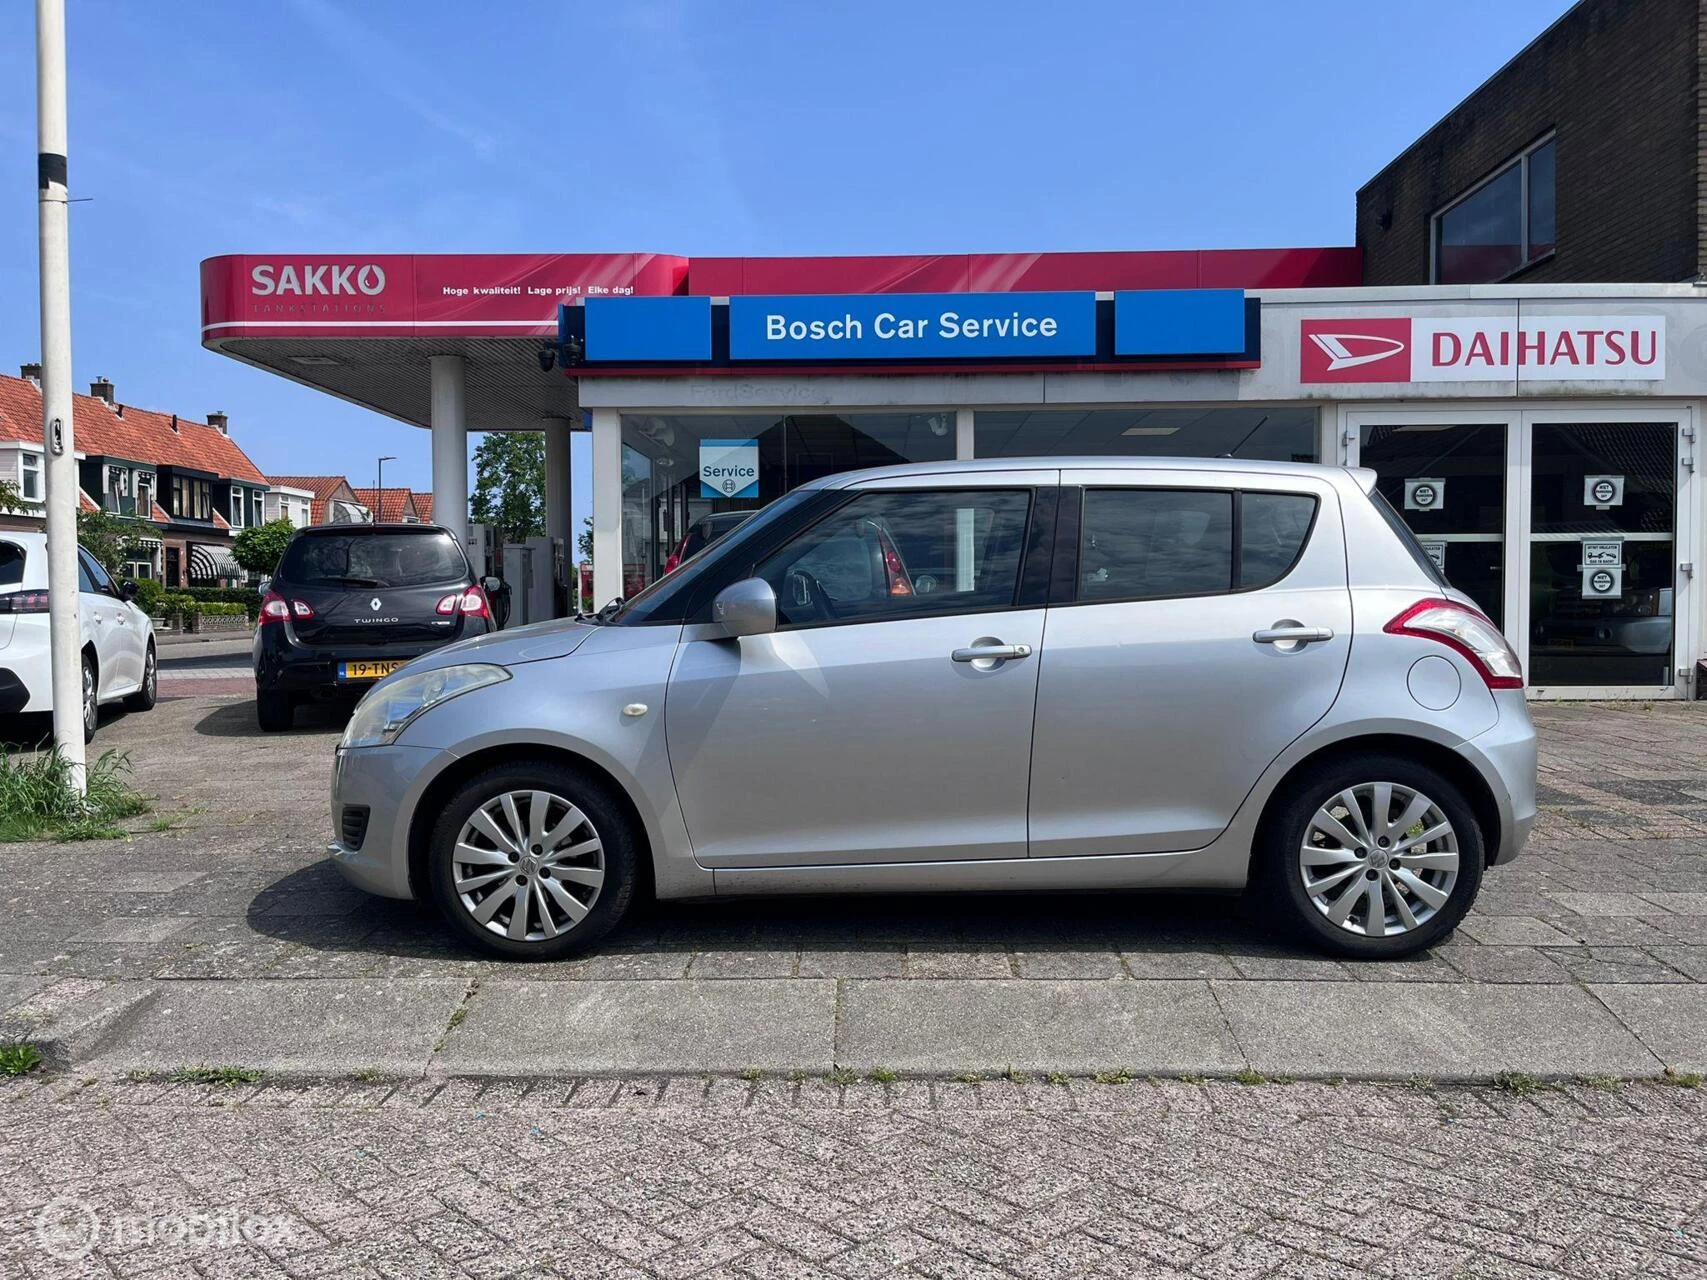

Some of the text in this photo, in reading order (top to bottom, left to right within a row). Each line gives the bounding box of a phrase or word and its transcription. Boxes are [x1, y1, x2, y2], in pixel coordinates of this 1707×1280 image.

[251, 264, 386, 296] SAKKO
[443, 286, 634, 296] Hoge kwaliteit! Lage prijs! Elke dag!
[253, 303, 386, 313] TANKSTATIONS
[766, 311, 1058, 340] Bosch Car Service
[1431, 331, 1657, 367] DAIHATSU
[703, 465, 755, 477] Service
